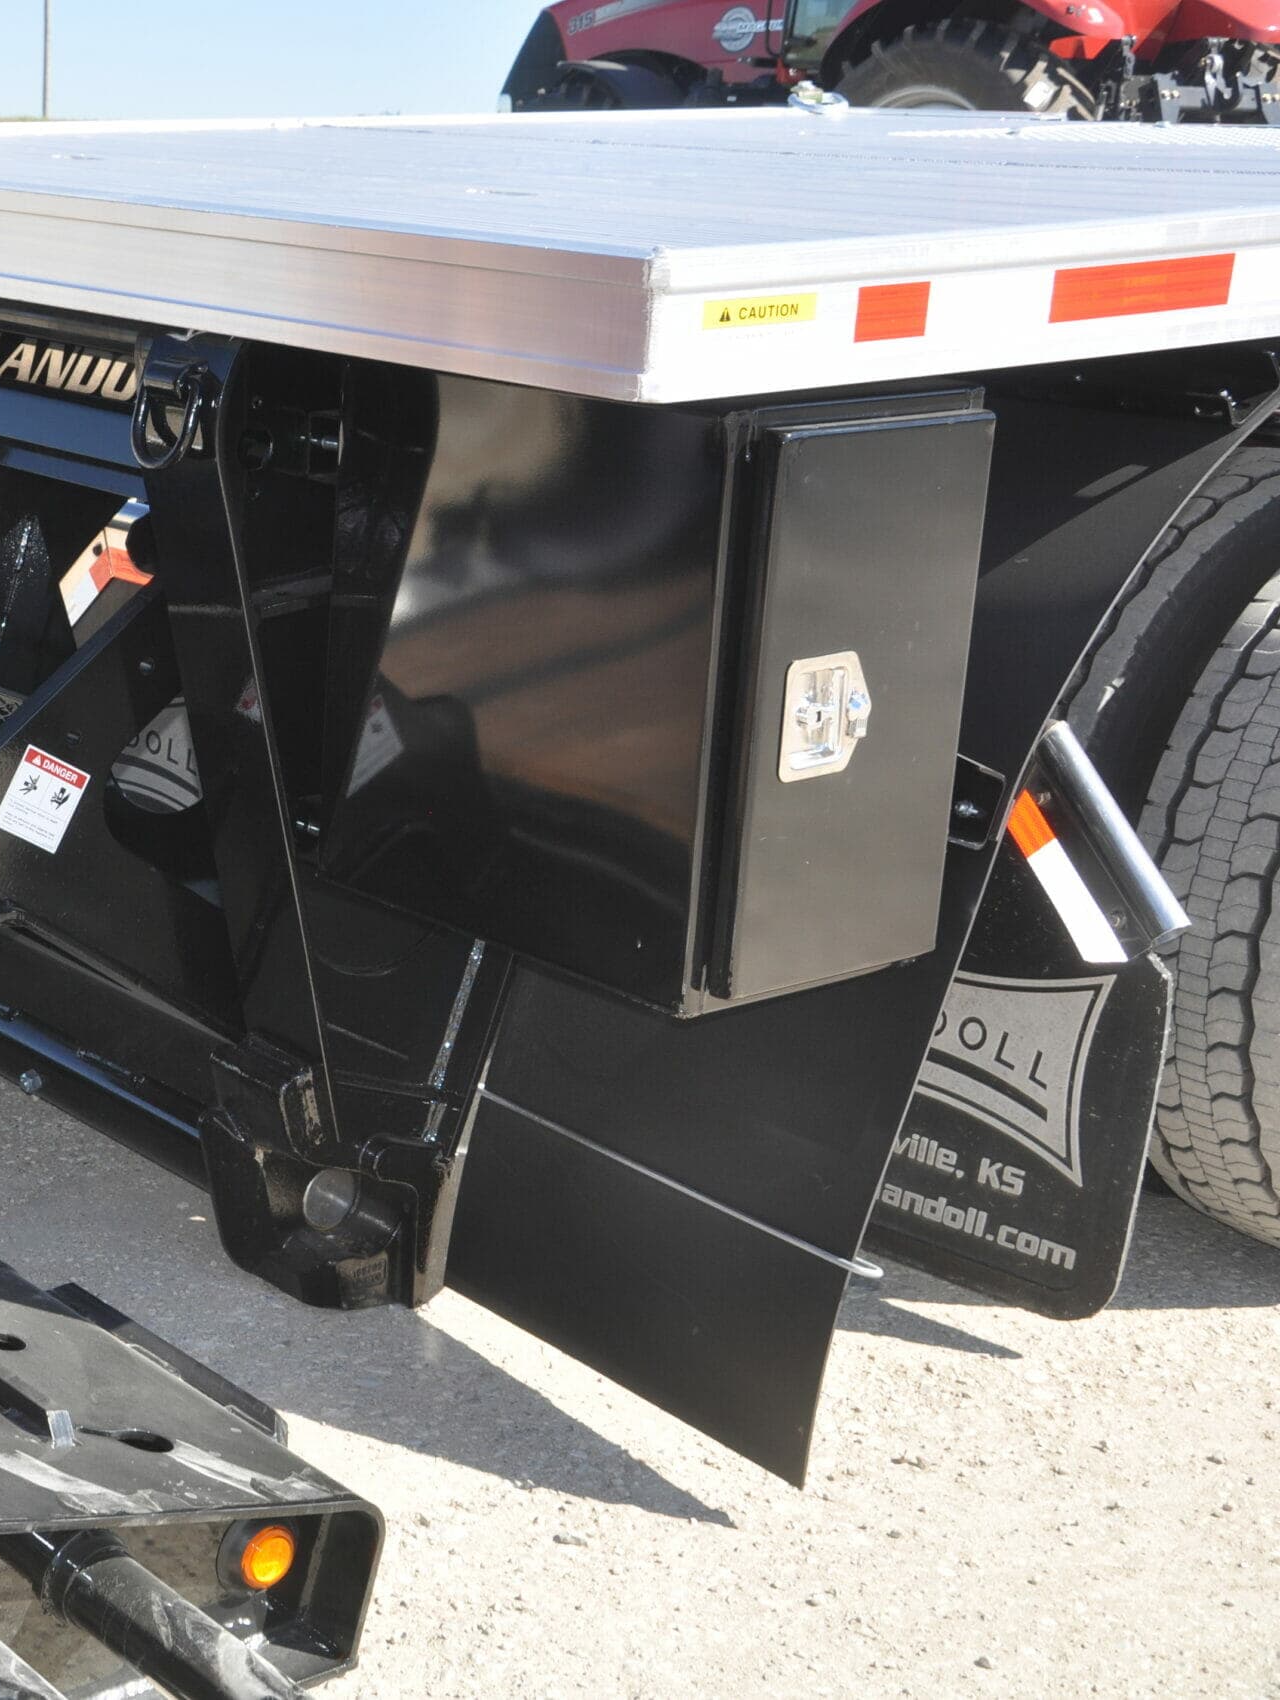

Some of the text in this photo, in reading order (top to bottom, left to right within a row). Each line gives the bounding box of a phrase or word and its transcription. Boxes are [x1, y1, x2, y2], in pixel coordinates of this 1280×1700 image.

[738, 303, 799, 320] CAUTION
[42, 759, 78, 784] DANGER
[977, 1157, 1026, 1196] KS
